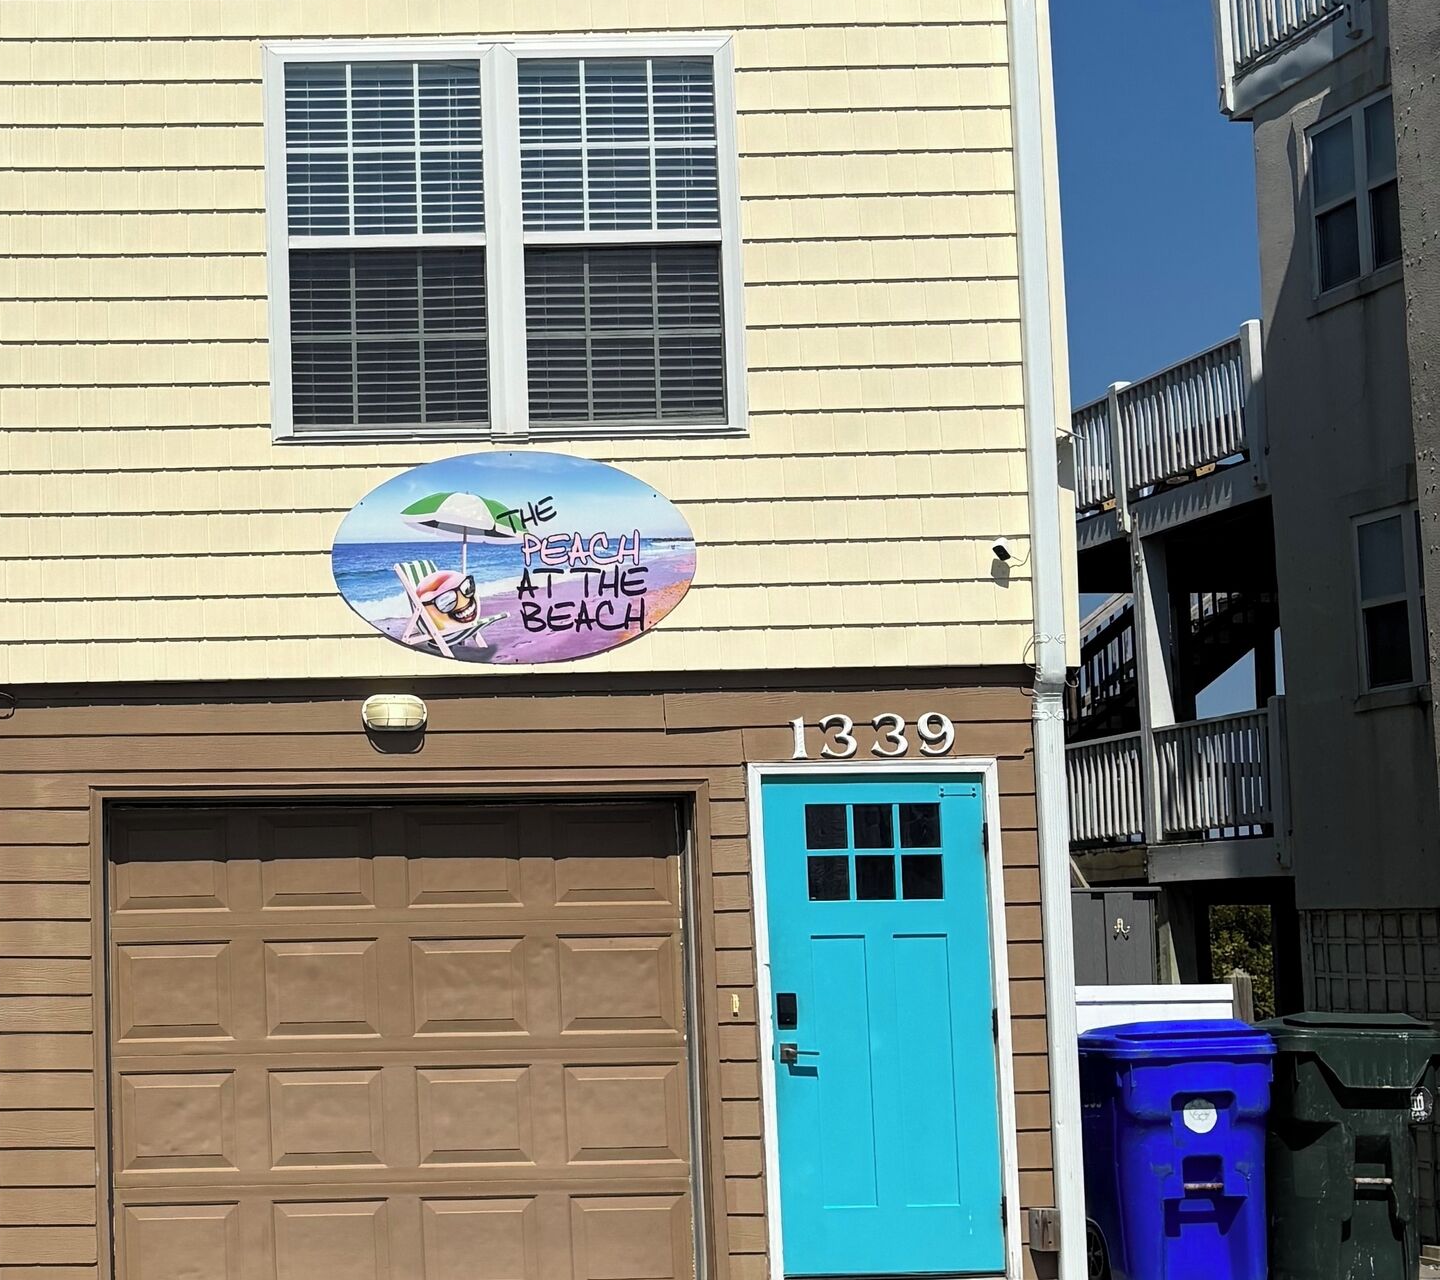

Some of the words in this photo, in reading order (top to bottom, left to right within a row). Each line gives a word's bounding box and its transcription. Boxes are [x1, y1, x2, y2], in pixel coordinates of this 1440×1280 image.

[496, 496, 558, 533] THE
[521, 529, 640, 567] PEACH
[516, 566, 565, 600] AT
[569, 566, 649, 598] THE
[519, 601, 646, 632] BEACH
[789, 711, 956, 760] 1339
